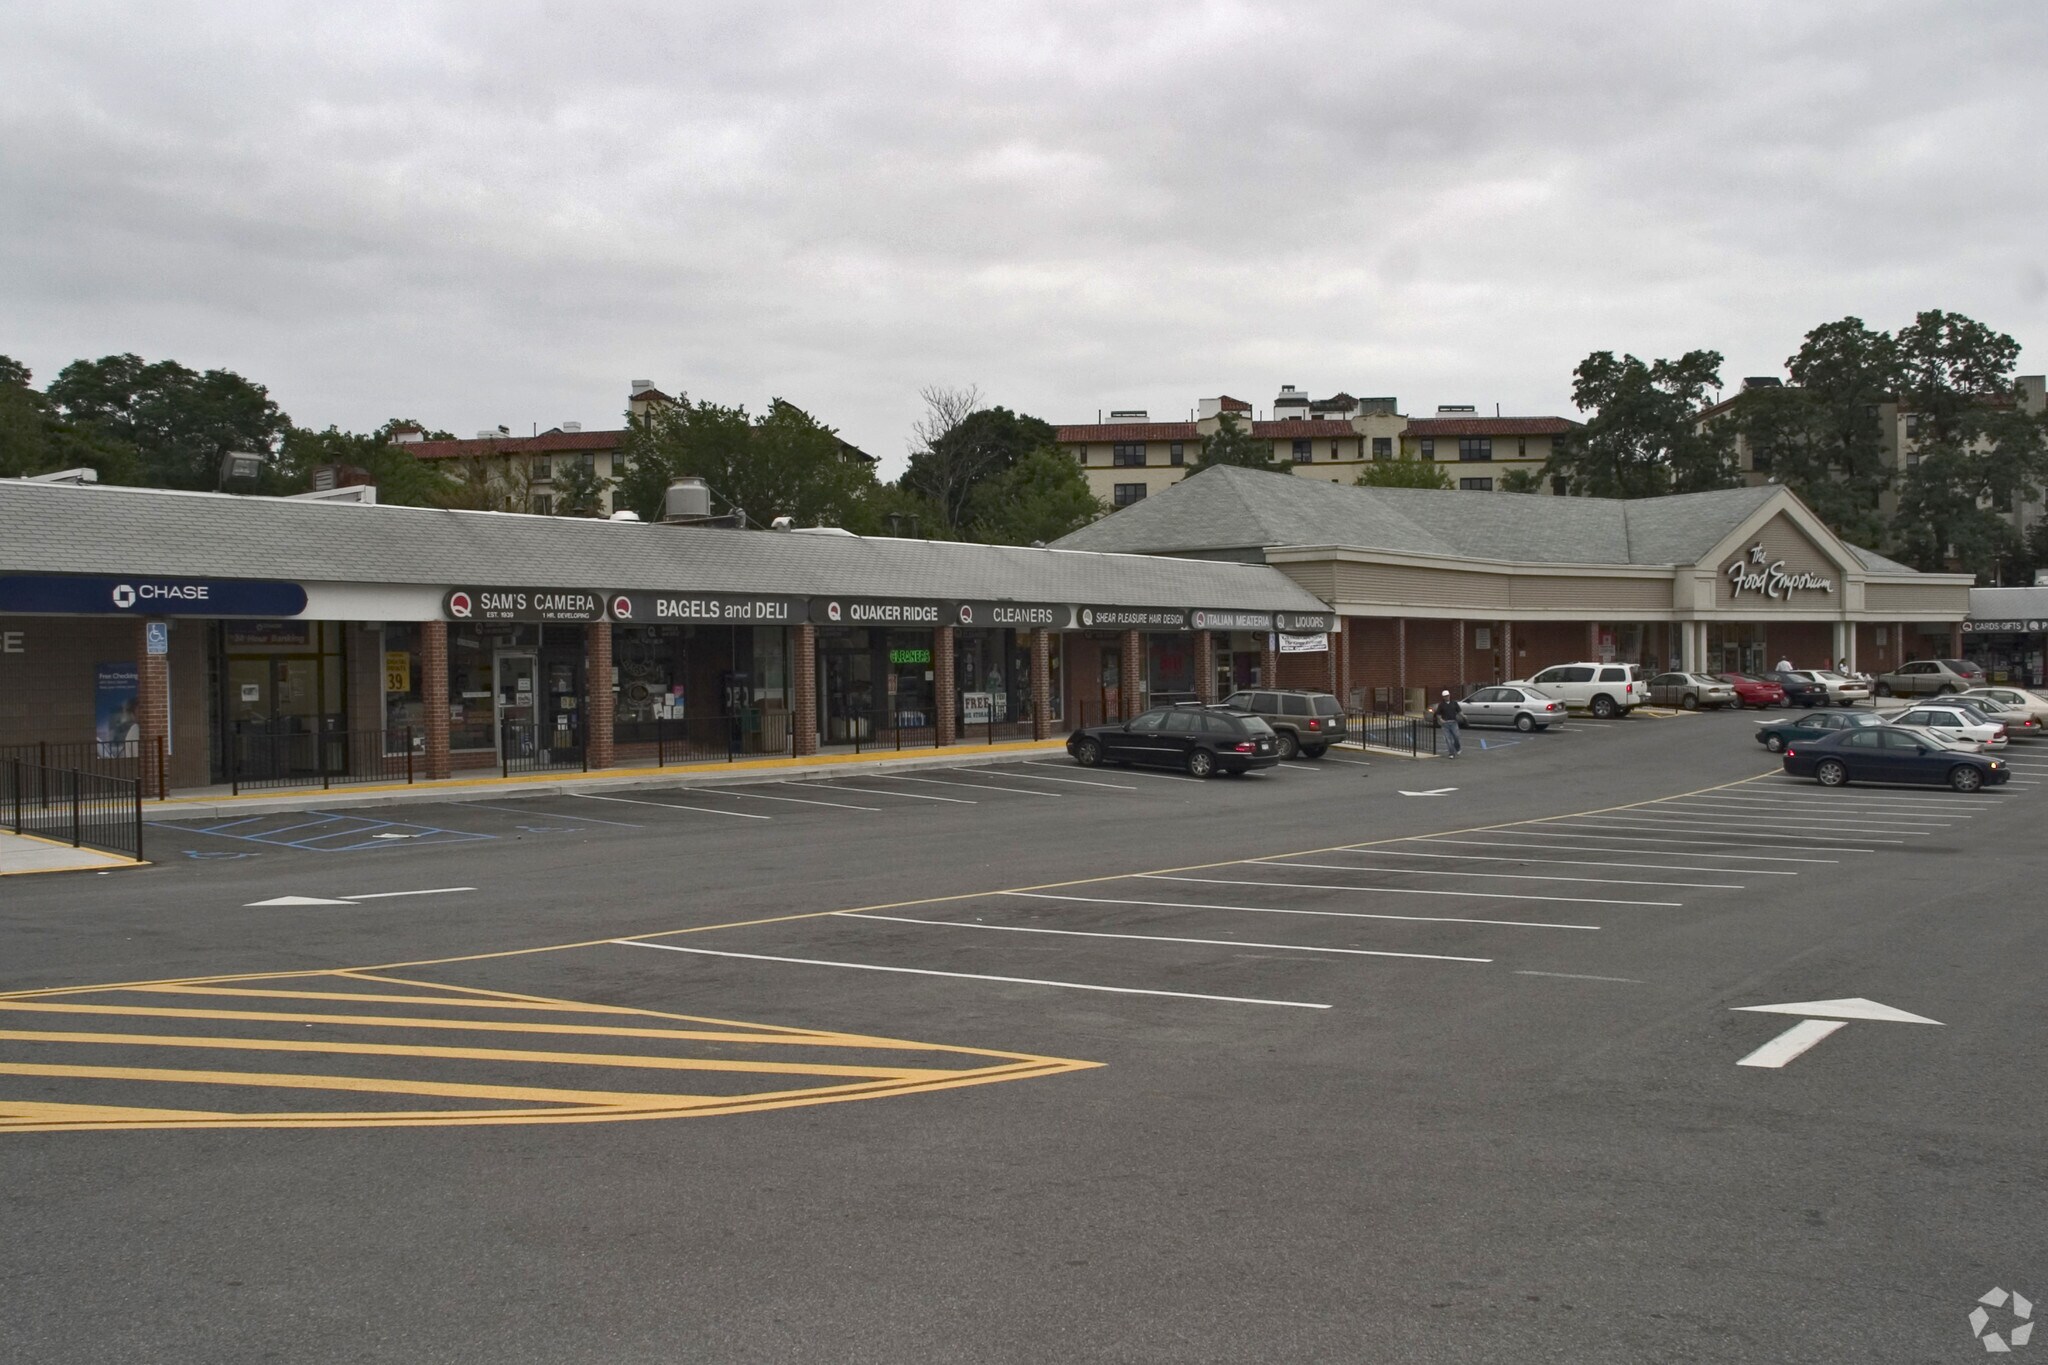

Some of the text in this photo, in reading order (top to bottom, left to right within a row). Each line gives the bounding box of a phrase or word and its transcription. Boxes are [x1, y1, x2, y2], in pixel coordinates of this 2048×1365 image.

[1751, 543, 1766, 564] The
[1728, 560, 1834, 600] Food Emporium
[139, 584, 209, 600] CHASE
[481, 592, 595, 610] SAM'S CAMERA
[451, 592, 472, 617] Q
[613, 596, 632, 618] Q
[656, 599, 787, 619] BAGELS and DELI
[828, 601, 841, 621] Q
[850, 604, 938, 621] QUAKER RIDGE
[960, 605, 973, 624] Q
[993, 608, 1053, 623] CLEANERS
[1096, 612, 1184, 624] SHEAR PLEASURE HAIR DESIGN
[1207, 614, 1233, 626] ITALIAN
[1295, 616, 1324, 628] LIQUORS
[0, 631, 25, 653] E
[890, 649, 931, 663] CLEANERS
[965, 696, 990, 709] FREE
